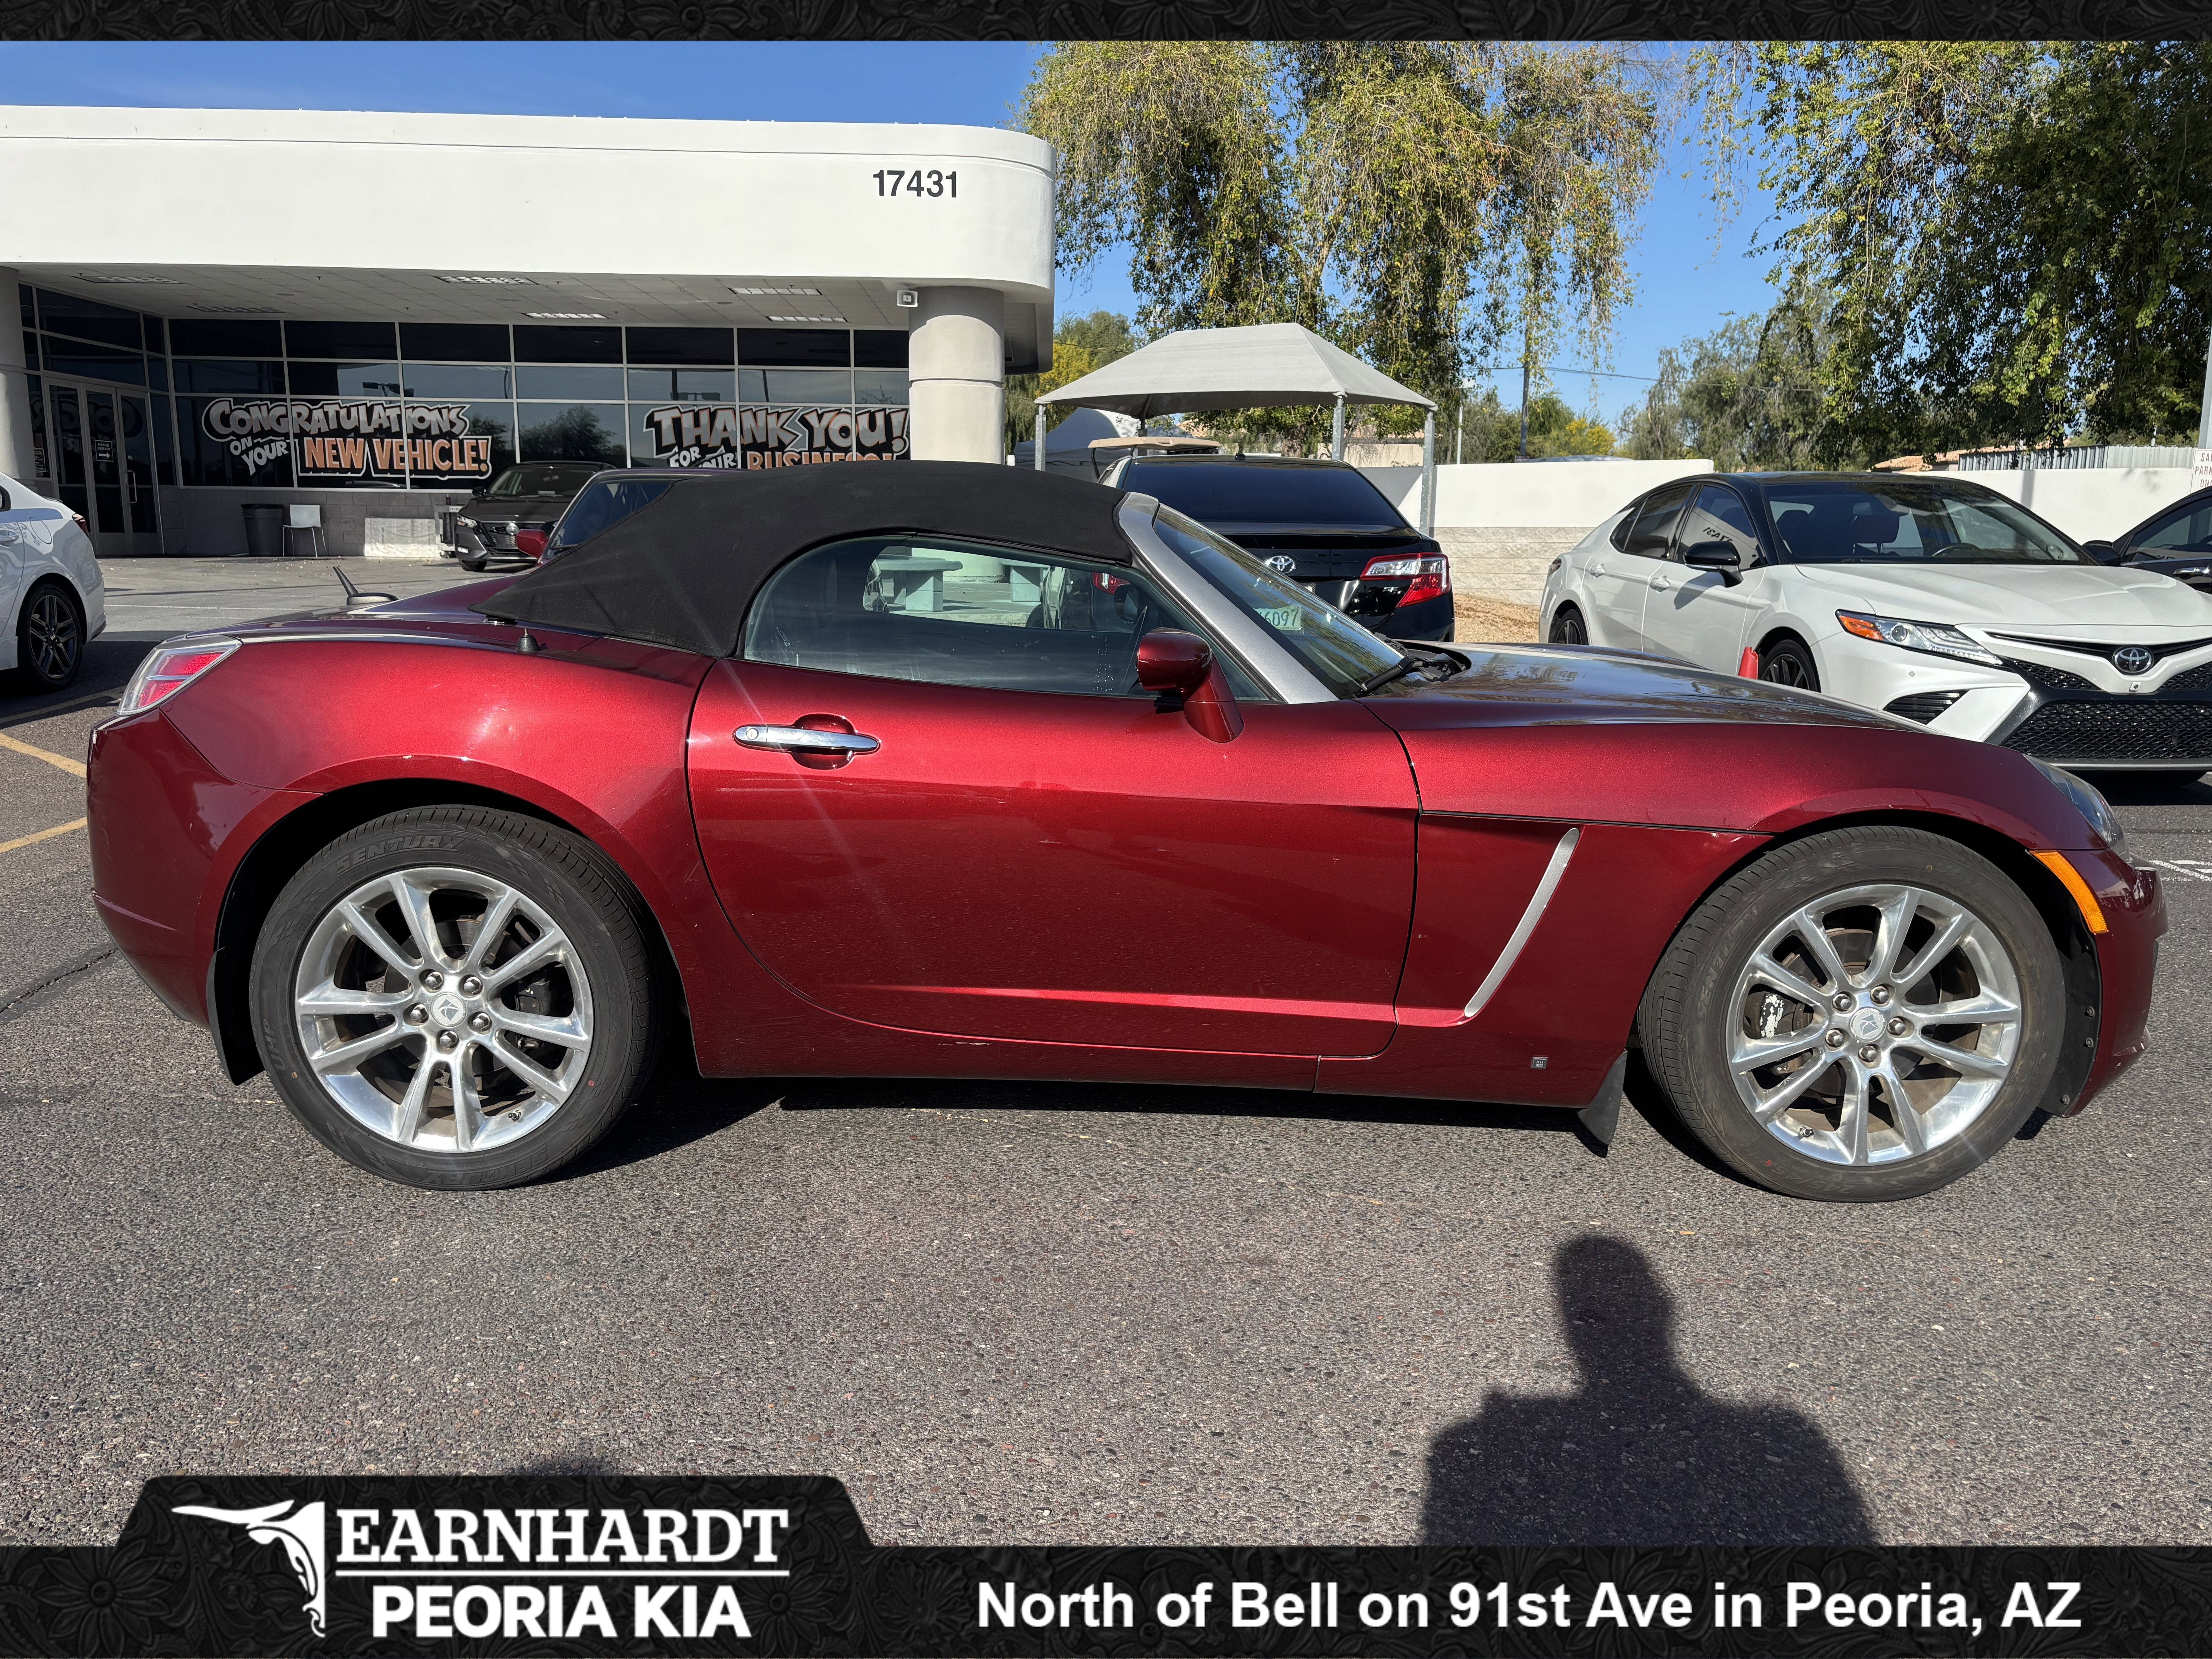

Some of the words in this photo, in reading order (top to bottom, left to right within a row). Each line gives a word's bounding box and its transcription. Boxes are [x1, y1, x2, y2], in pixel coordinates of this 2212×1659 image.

[873, 170, 957, 198] 17431
[209, 400, 468, 435] CONGRATULATIONS
[654, 408, 803, 447] THANK
[805, 409, 908, 452] YOU!
[231, 436, 252, 455] ON
[242, 441, 290, 476] YOUR
[305, 437, 364, 469] NEW
[373, 438, 488, 472] VEHICLE!
[670, 446, 702, 467] FOR
[337, 834, 465, 878] SENTURY
[263, 1018, 289, 1072] UHP
